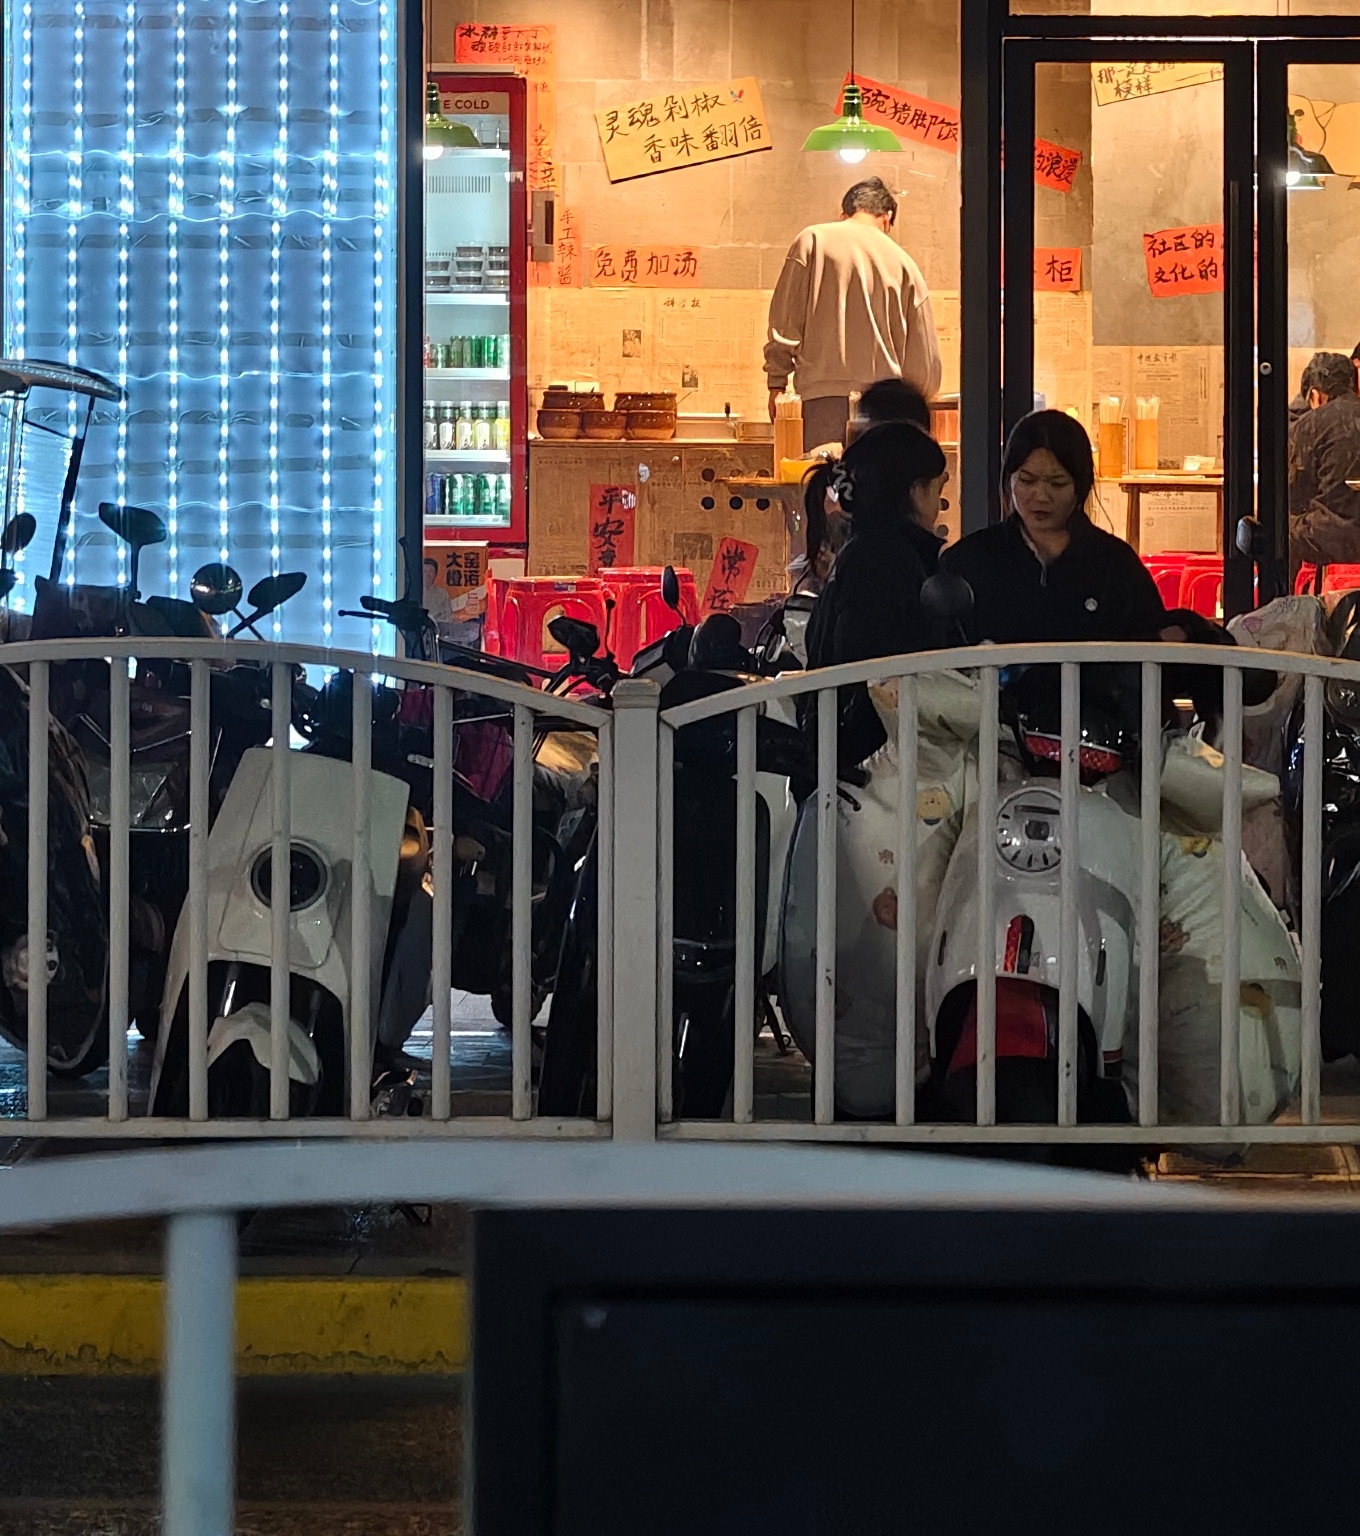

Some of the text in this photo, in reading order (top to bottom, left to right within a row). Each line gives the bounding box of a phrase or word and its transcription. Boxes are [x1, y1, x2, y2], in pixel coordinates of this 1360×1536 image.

[454, 99, 490, 110] COLD
[1113, 78, 1153, 100] 模样
[605, 93, 724, 145] 灵魂剁椒
[641, 114, 765, 165] 香味翻倍
[1147, 229, 1215, 260] 社区的
[594, 249, 698, 284] 免费加汤
[1153, 257, 1218, 285] 文化的
